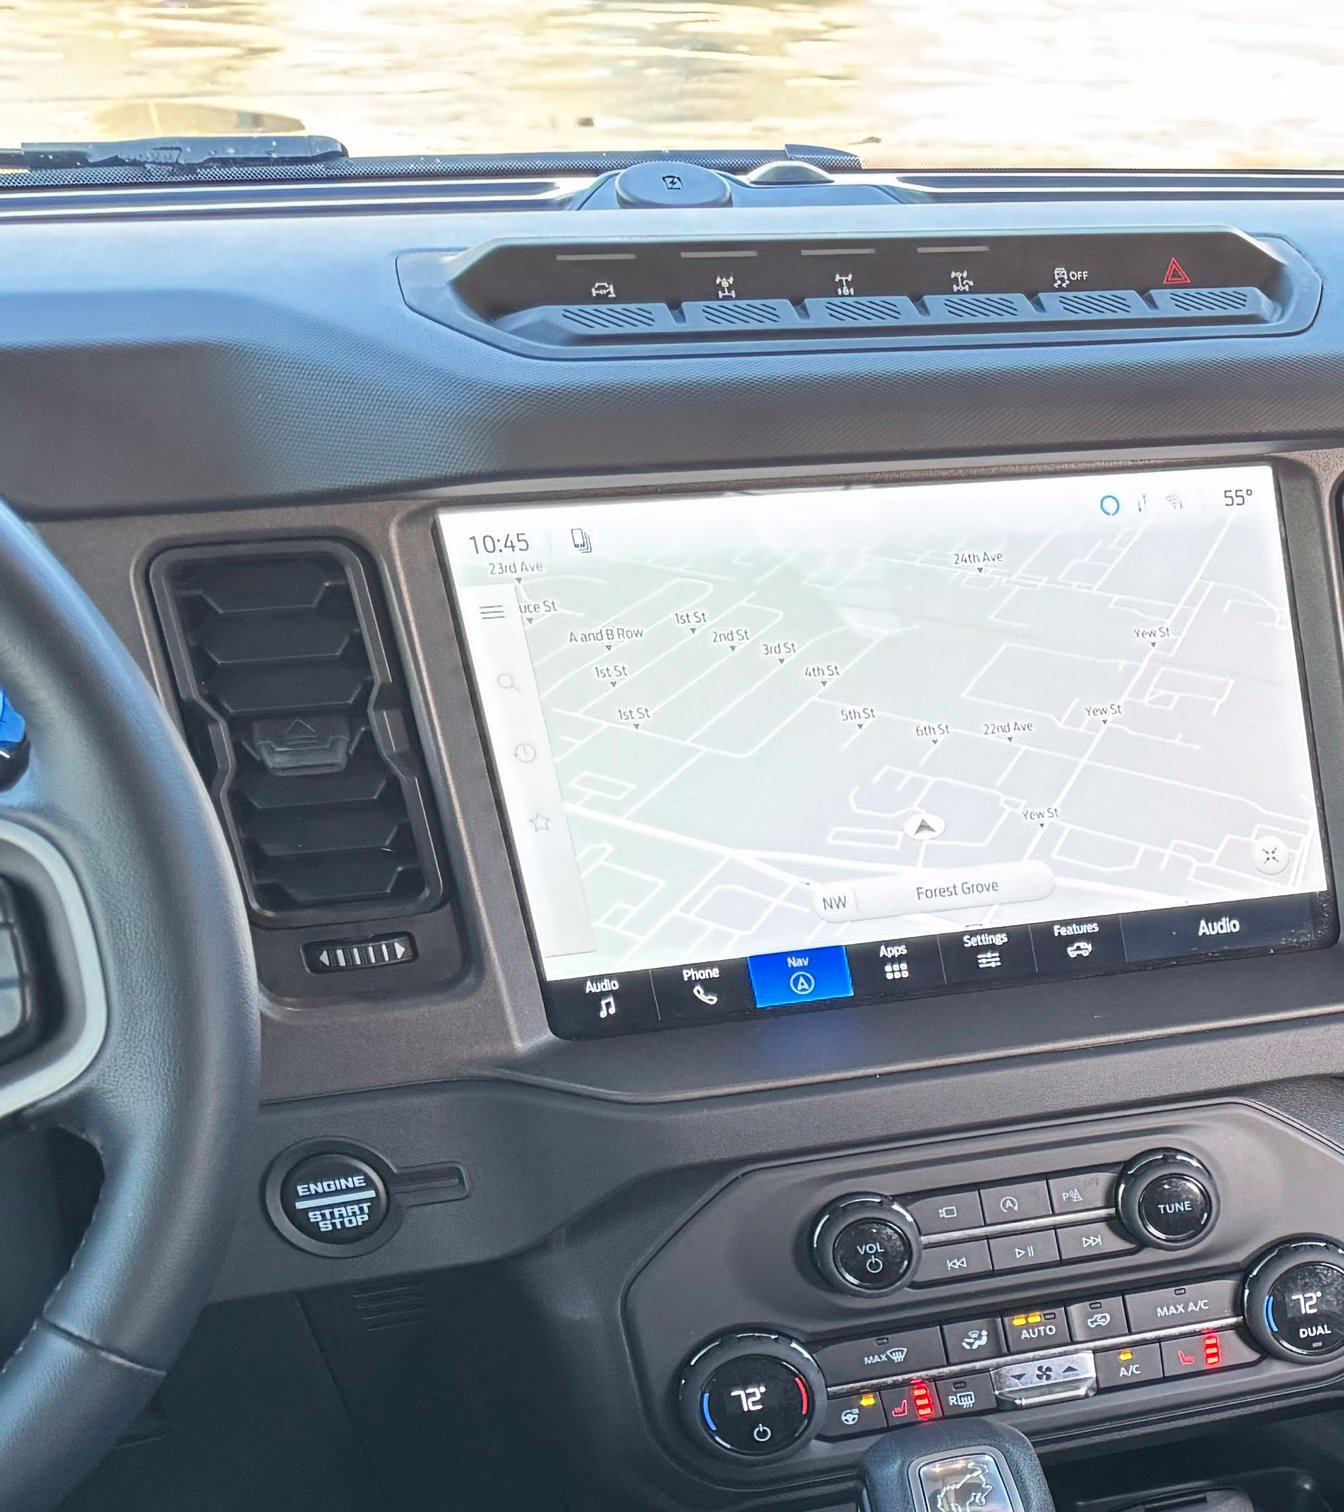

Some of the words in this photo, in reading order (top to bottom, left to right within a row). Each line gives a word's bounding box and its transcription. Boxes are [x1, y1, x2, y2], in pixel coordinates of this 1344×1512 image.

[1069, 271, 1089, 281] OFF
[469, 533, 530, 555] 10:45
[953, 553, 978, 564] 24th
[980, 551, 1003, 562] Ave
[489, 561, 517, 575] 23rd
[520, 560, 544, 573] Ave
[543, 600, 558, 612] St
[675, 613, 690, 625] 1st
[691, 612, 707, 624] St
[580, 629, 603, 641] and
[605, 629, 615, 640] B
[617, 627, 644, 639] Row
[713, 630, 733, 643] 2nd
[734, 629, 749, 641] St
[1134, 628, 1156, 640] Yew
[1158, 626, 1171, 638] St
[763, 643, 781, 655] 3rd
[782, 641, 796, 653] St
[595, 667, 611, 679] 1st
[613, 664, 628, 677] St
[805, 665, 824, 677] 4th
[825, 664, 840, 676] St
[618, 708, 634, 721] 1st
[636, 706, 651, 719] St
[841, 709, 860, 721] 5th
[860, 707, 876, 719] St
[1085, 704, 1108, 717] Yew
[1109, 703, 1122, 715] St
[915, 725, 933, 737] 6th
[935, 723, 950, 735] St
[984, 721, 1008, 734] 22nd
[1009, 719, 1033, 732] Ave
[1022, 809, 1044, 820] Yew
[1046, 807, 1059, 818] St
[916, 883, 958, 900] Forest
[960, 878, 999, 897] Grove
[822, 895, 847, 911] NW
[1053, 921, 1099, 937] Features
[1198, 917, 1240, 937] Audio
[963, 930, 1008, 948] Settings
[879, 943, 907, 959] Apps
[787, 956, 809, 968] Nav
[682, 966, 720, 981] Phone
[585, 979, 619, 994] Audio
[296, 1175, 367, 1197] ENGINE
[308, 1203, 372, 1223] START
[1158, 1201, 1192, 1214] TUNE
[319, 1214, 370, 1232] STOP
[857, 1242, 885, 1255] VOL
[1157, 1304, 1185, 1317] MAX
[1187, 1300, 1210, 1312] A/C
[1292, 1291, 1322, 1315] 72°
[1021, 1325, 1056, 1340] AUTO
[1299, 1325, 1331, 1339] DUAL
[864, 1354, 888, 1365] MAX
[1119, 1364, 1141, 1377] A/C
[731, 1386, 767, 1412] 72°
